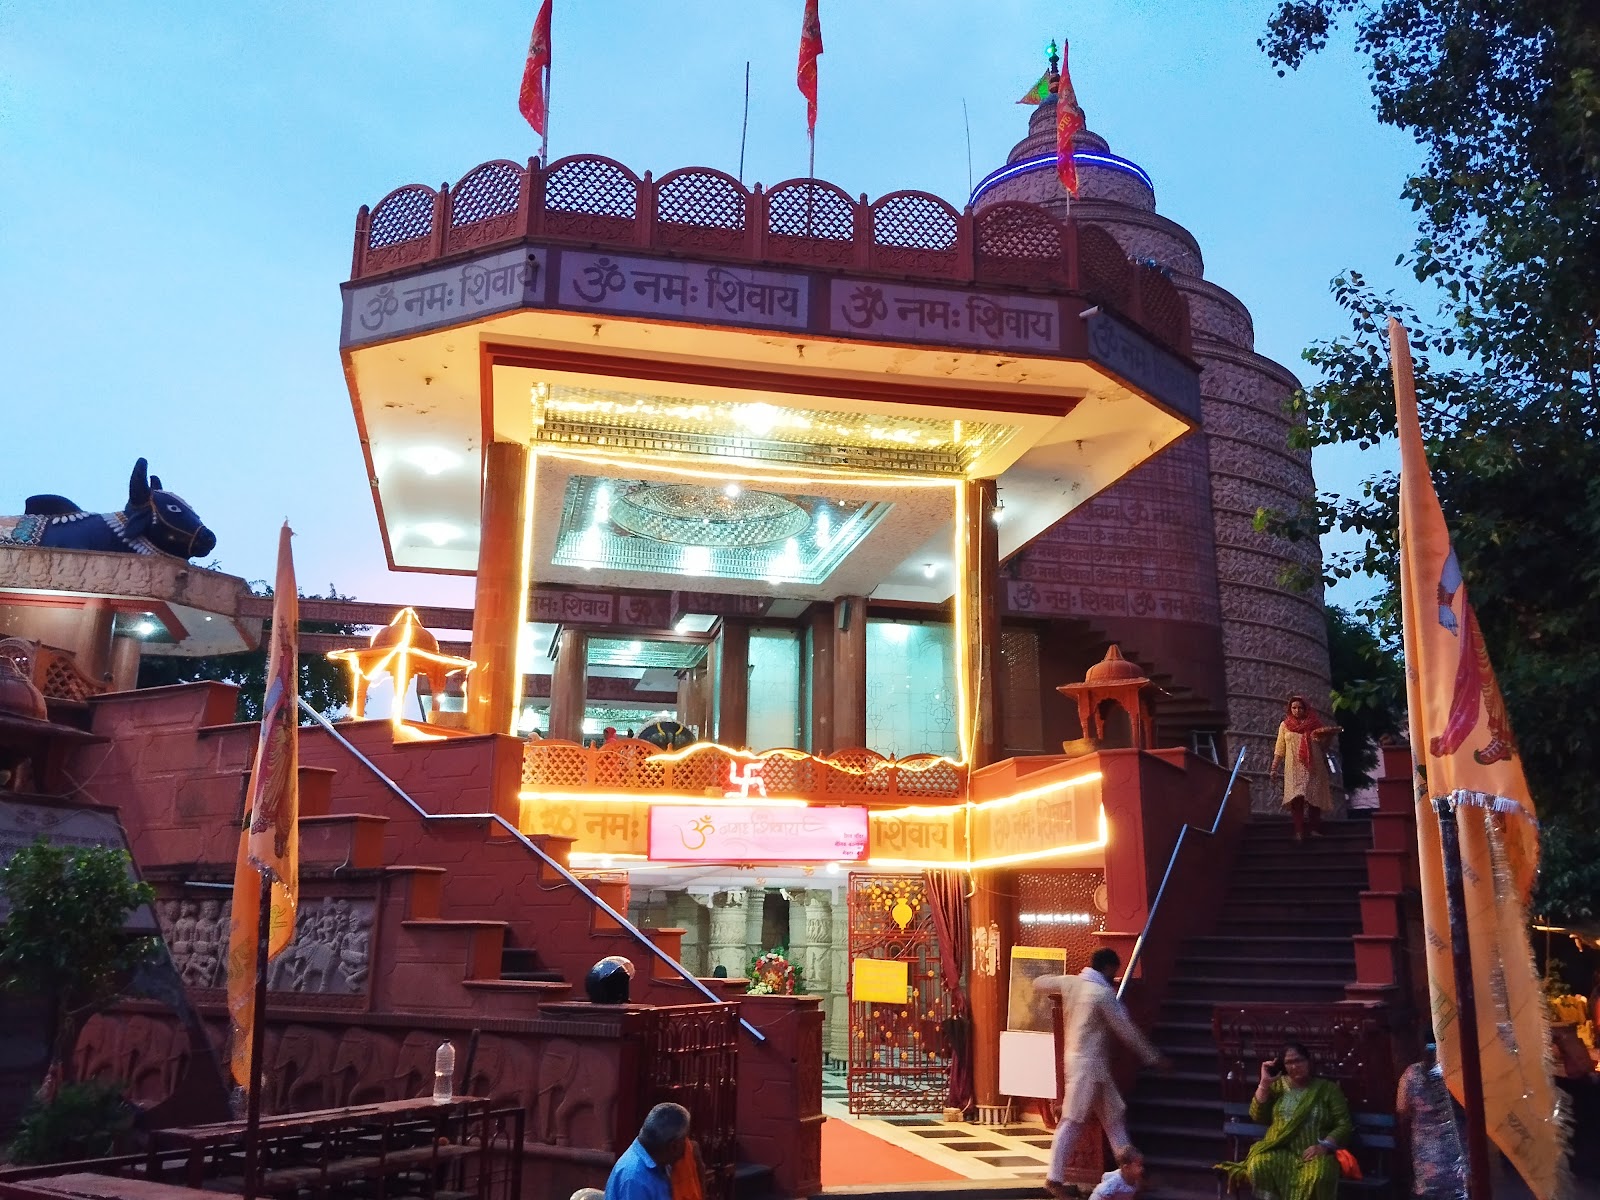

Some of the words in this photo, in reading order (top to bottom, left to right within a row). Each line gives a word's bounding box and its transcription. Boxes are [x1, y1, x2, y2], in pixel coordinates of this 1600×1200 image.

[359, 283, 399, 331] ॐ
[403, 281, 455, 317] नमः
[459, 258, 538, 307] शिवाय
[572, 257, 626, 304] ॐ
[632, 269, 699, 306] नमः
[704, 267, 799, 318] शिवाय
[841, 285, 889, 330] ॐ
[893, 296, 961, 331] नमः
[965, 295, 1055, 342] शिवाय
[562, 594, 610, 618] शिवाय
[1013, 582, 1041, 609] ॐ
[583, 812, 640, 841] नमः
[672, 814, 716, 851] ॐ
